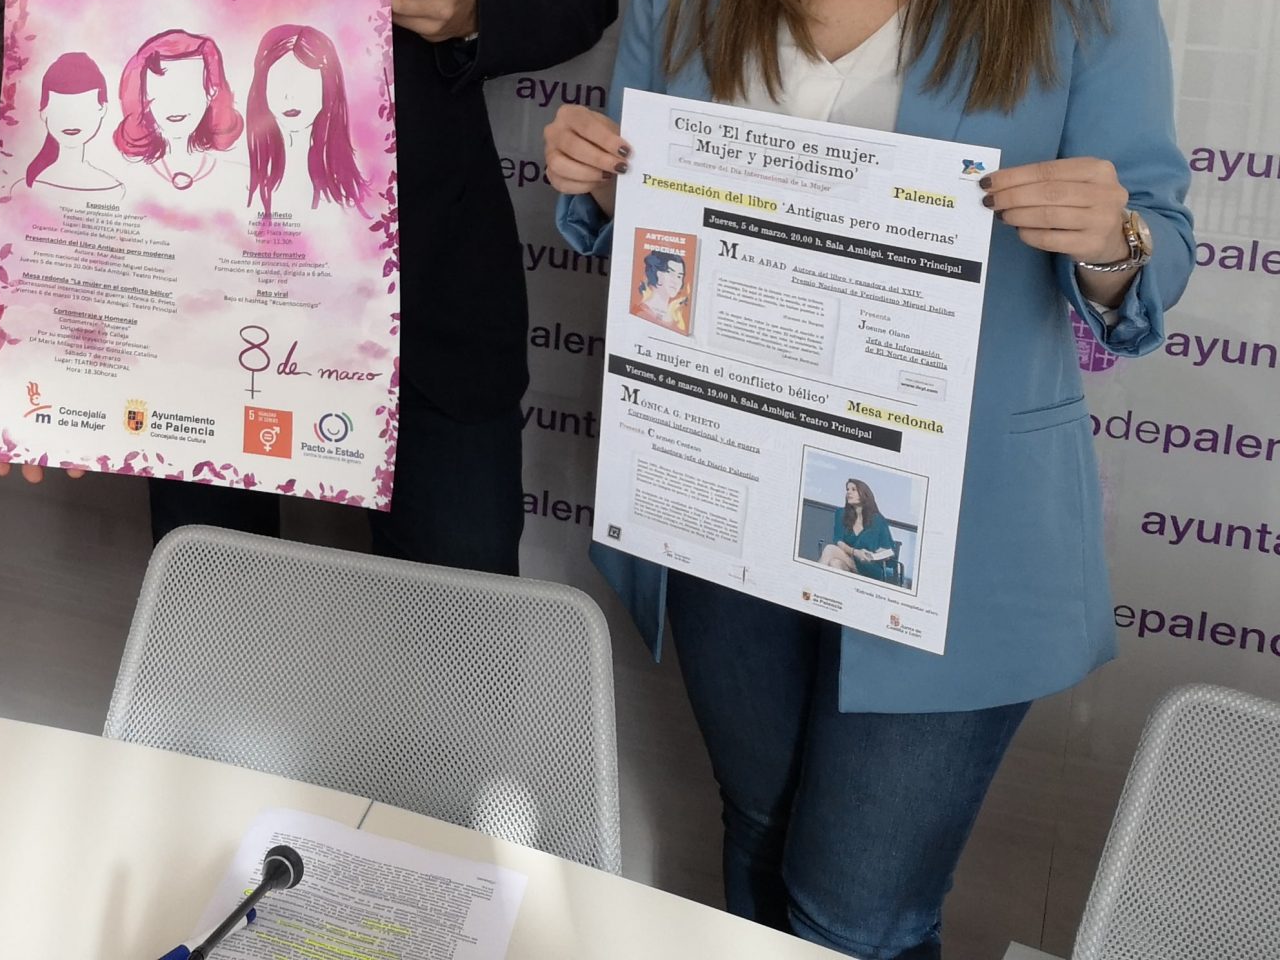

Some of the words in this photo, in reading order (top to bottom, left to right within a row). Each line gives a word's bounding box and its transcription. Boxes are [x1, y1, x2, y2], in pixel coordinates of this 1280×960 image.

[674, 117, 712, 135] Ciclo
[745, 129, 796, 150] futuro
[802, 141, 819, 154] es
[826, 145, 880, 166] mujer.
[696, 139, 742, 160] Mujer
[748, 151, 756, 163] y
[1190, 147, 1280, 182] ayu
[86, 202, 120, 211] Exposición
[642, 173, 720, 200] Presentación
[725, 191, 743, 204] del
[748, 195, 778, 211] libro
[849, 217, 880, 232] pero
[893, 186, 955, 209] Palencia
[748, 224, 758, 232] de
[825, 240, 844, 251] Sala
[887, 252, 917, 265] Teatro
[920, 258, 962, 273] Principal
[759, 257, 787, 271] ABAD
[239, 325, 270, 372] 8
[277, 340, 312, 376] de
[318, 368, 383, 381] marzo
[656, 351, 691, 368] mujer
[696, 363, 709, 373] en
[714, 367, 724, 377] el
[729, 372, 783, 393] conflicto
[59, 407, 106, 419] Concejalía
[152, 410, 215, 426] Ayuntamiento
[249, 410, 254, 420] 5
[666, 377, 676, 385] de
[741, 397, 759, 409] Sala
[800, 413, 829, 427] Teatro
[831, 421, 872, 439] Principal
[848, 400, 882, 418] Mesa
[887, 412, 944, 434] redonda
[58, 419, 69, 427] de
[71, 420, 79, 428] la
[81, 421, 106, 431] Mujer
[151, 422, 162, 430] de
[166, 423, 215, 437] Palencia
[685, 412, 720, 429] PRIETO
[301, 442, 325, 453] Pacto
[335, 448, 364, 459] Estado
